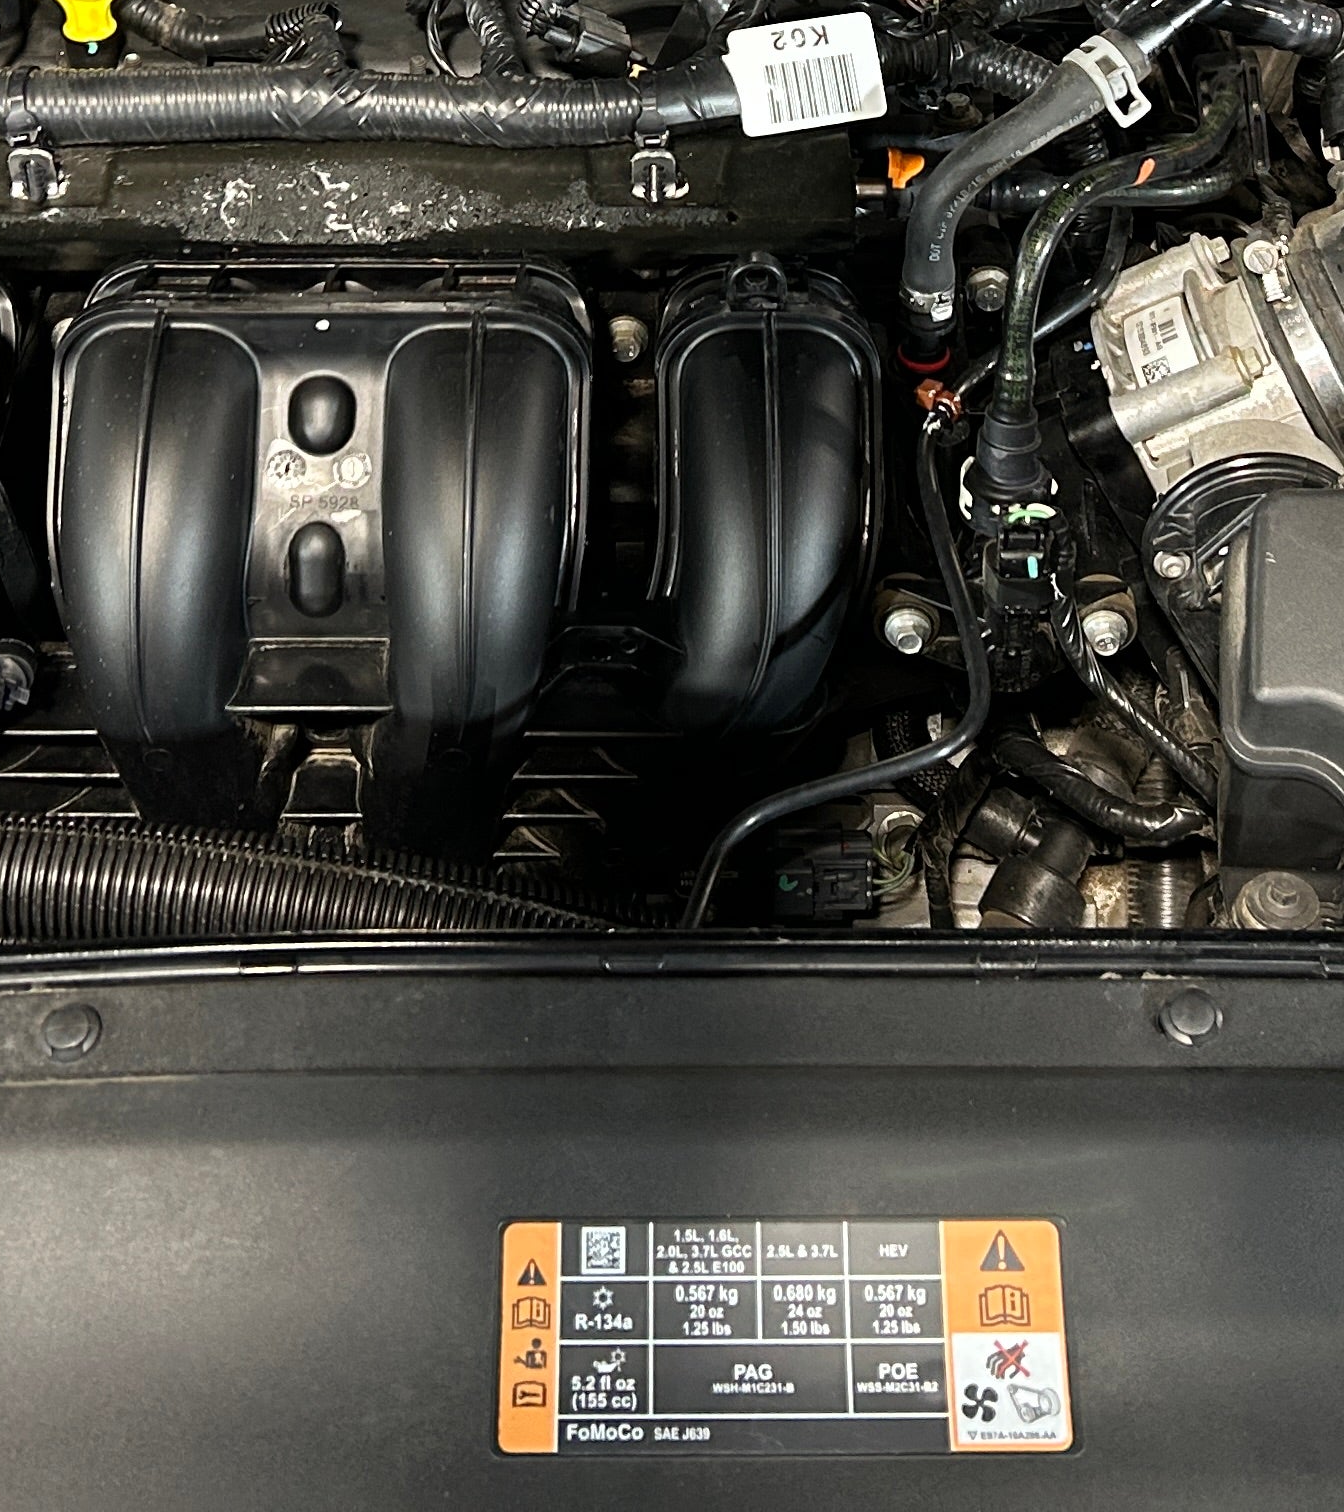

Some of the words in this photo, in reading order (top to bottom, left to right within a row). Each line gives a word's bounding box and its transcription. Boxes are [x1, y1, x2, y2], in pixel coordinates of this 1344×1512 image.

[289, 494, 313, 509] SP
[317, 494, 360, 510] 5928
[674, 1228, 705, 1243] 1.5L,
[691, 1244, 719, 1258] 3.7L
[722, 1244, 752, 1258] GCC
[766, 1244, 795, 1258] 2.5L
[797, 1244, 808, 1258] &
[811, 1244, 839, 1258] 3.7L
[879, 1243, 908, 1257] HEV
[668, 1261, 678, 1274] &
[682, 1261, 709, 1274] 2.5L
[713, 1261, 745, 1274] E100
[675, 1285, 715, 1302] 0.567
[719, 1285, 738, 1306] kg
[772, 1285, 813, 1302] 0.680
[817, 1284, 837, 1305] kg
[863, 1284, 904, 1302] 0.567
[907, 1284, 927, 1305] kg
[690, 1304, 705, 1319] 20
[708, 1307, 725, 1319] oz
[788, 1304, 803, 1318] 24
[806, 1307, 823, 1318] oz
[879, 1304, 895, 1318] 20
[897, 1307, 913, 1318] oz
[574, 1313, 634, 1330] R-134a
[682, 1321, 710, 1336] 1.25
[712, 1321, 732, 1336] lbs
[781, 1321, 808, 1336] 1.50
[810, 1321, 830, 1336] lbs
[872, 1320, 899, 1335] 1.25
[901, 1320, 921, 1335] lbs
[733, 1363, 773, 1380] PAG
[878, 1363, 918, 1379] POE
[571, 1375, 596, 1391] 5.2
[599, 1375, 611, 1391] fl
[615, 1378, 636, 1391] oz
[572, 1393, 607, 1411] (155
[611, 1393, 638, 1411] cc)
[566, 1423, 645, 1441] FoMoCo
[654, 1427, 680, 1441] SAE
[682, 1427, 711, 1441] J639
